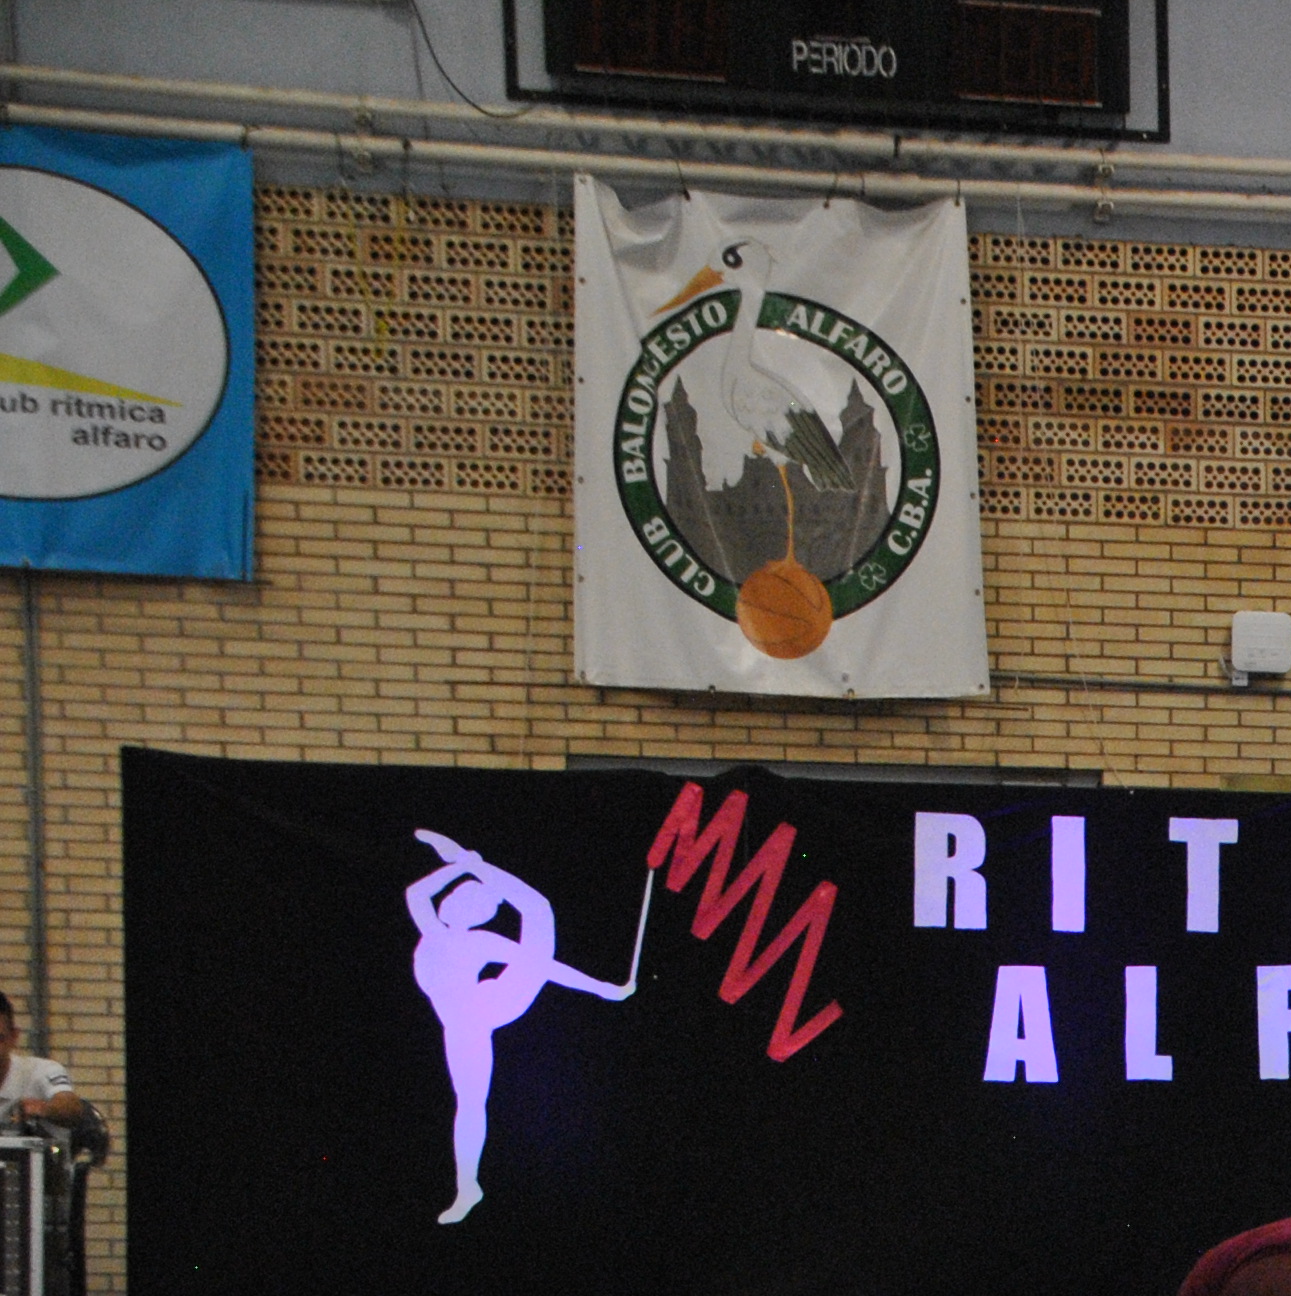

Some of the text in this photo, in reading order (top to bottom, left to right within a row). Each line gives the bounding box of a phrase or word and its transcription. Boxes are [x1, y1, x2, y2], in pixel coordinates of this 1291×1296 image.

[791, 40, 898, 79] PERIODO
[71, 424, 167, 451] alfaro
[642, 515, 716, 598] CLUB
[786, 303, 908, 396] ALFARO
[886, 466, 933, 557] C.B.A.
